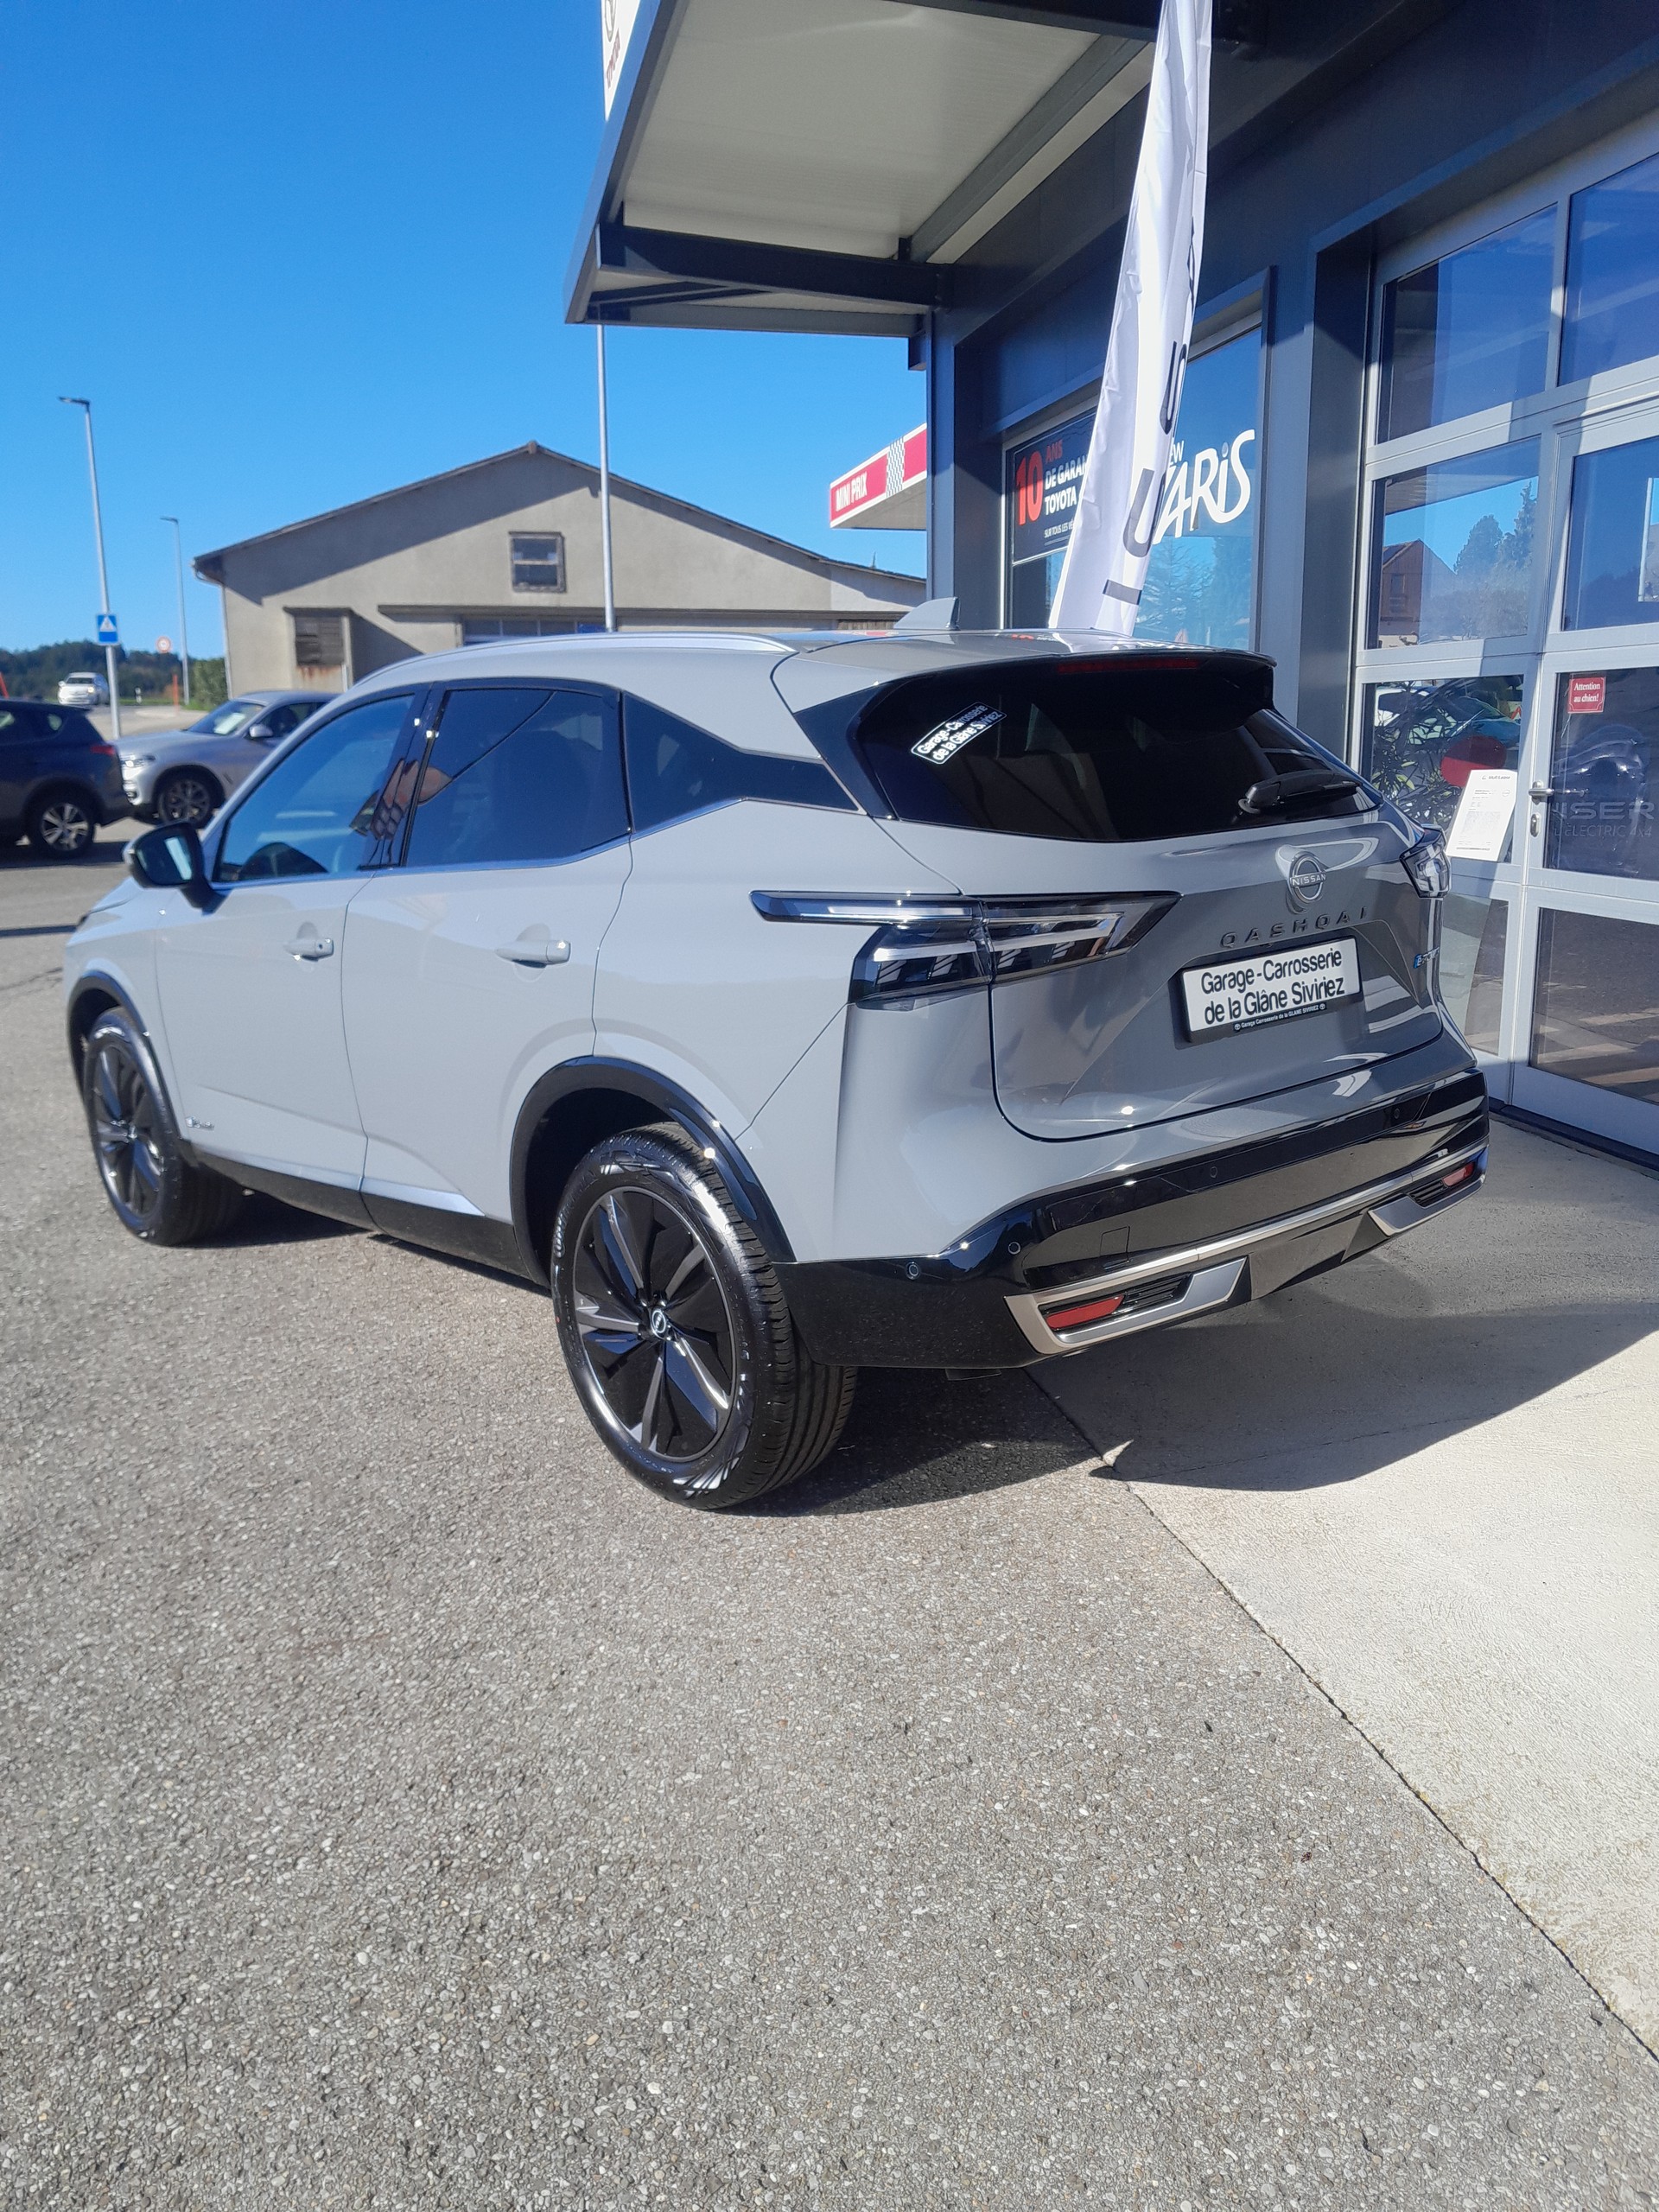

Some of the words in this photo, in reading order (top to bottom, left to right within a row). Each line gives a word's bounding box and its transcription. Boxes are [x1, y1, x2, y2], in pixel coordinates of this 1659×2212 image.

[1046, 440, 1063, 463] ANS
[1016, 451, 1043, 525] 10
[1045, 467, 1056, 490] DE
[836, 480, 851, 512] MINI
[851, 471, 868, 504] PRIX
[1045, 486, 1077, 515] TOYOTA
[1052, 524, 1062, 536] TOUS
[1573, 682, 1600, 691] Attention
[1581, 693, 1599, 702] chien!
[932, 747, 950, 760] de
[1292, 873, 1326, 887] NISSAN
[1220, 906, 1367, 949] QASHQAI
[1205, 1001, 1224, 1025] de
[1228, 996, 1242, 1020] la
[1243, 989, 1287, 1016] Glâne
[1291, 976, 1345, 1005] Siviriez
